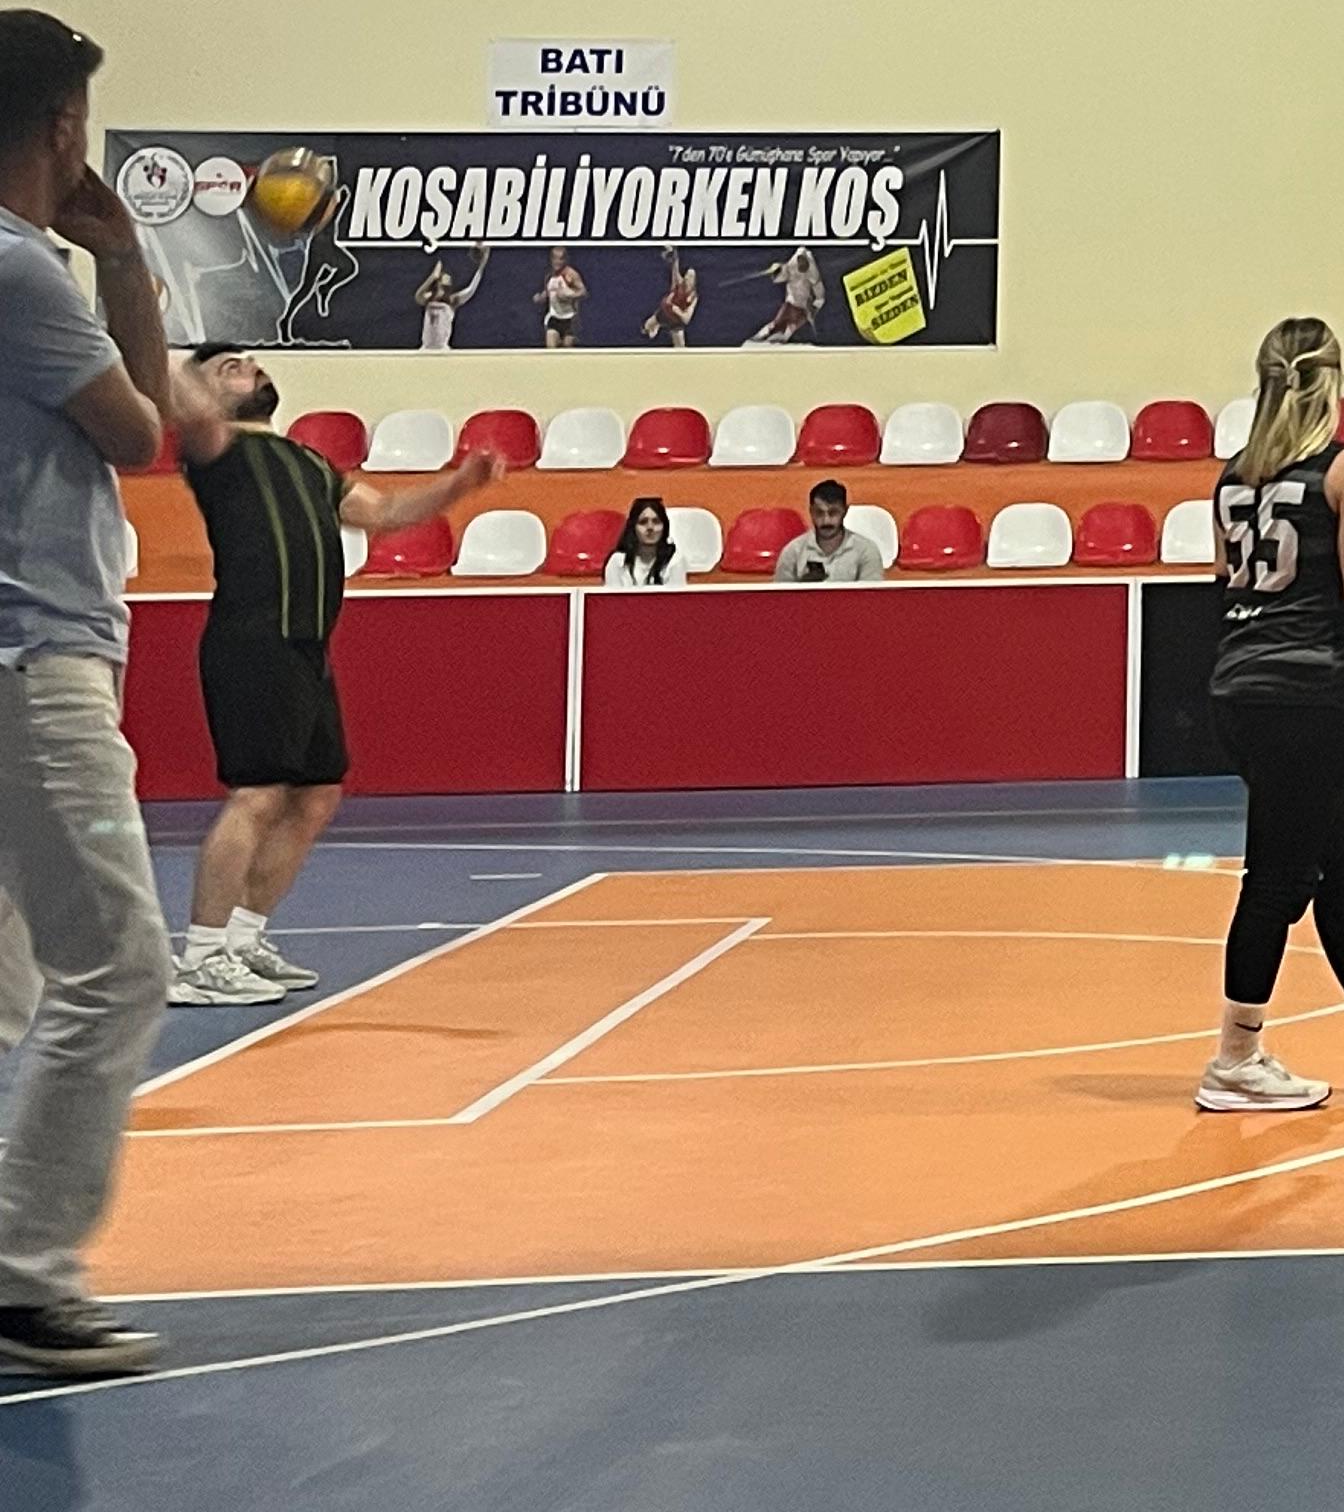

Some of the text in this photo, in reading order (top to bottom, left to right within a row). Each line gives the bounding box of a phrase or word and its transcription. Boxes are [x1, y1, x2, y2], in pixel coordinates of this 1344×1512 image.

[540, 48, 623, 74] BATI
[495, 84, 666, 117] TRİBÜNÜ
[349, 154, 904, 253] KOŞABİLİYORKEN KOŞ
[1219, 480, 1307, 592] 55
